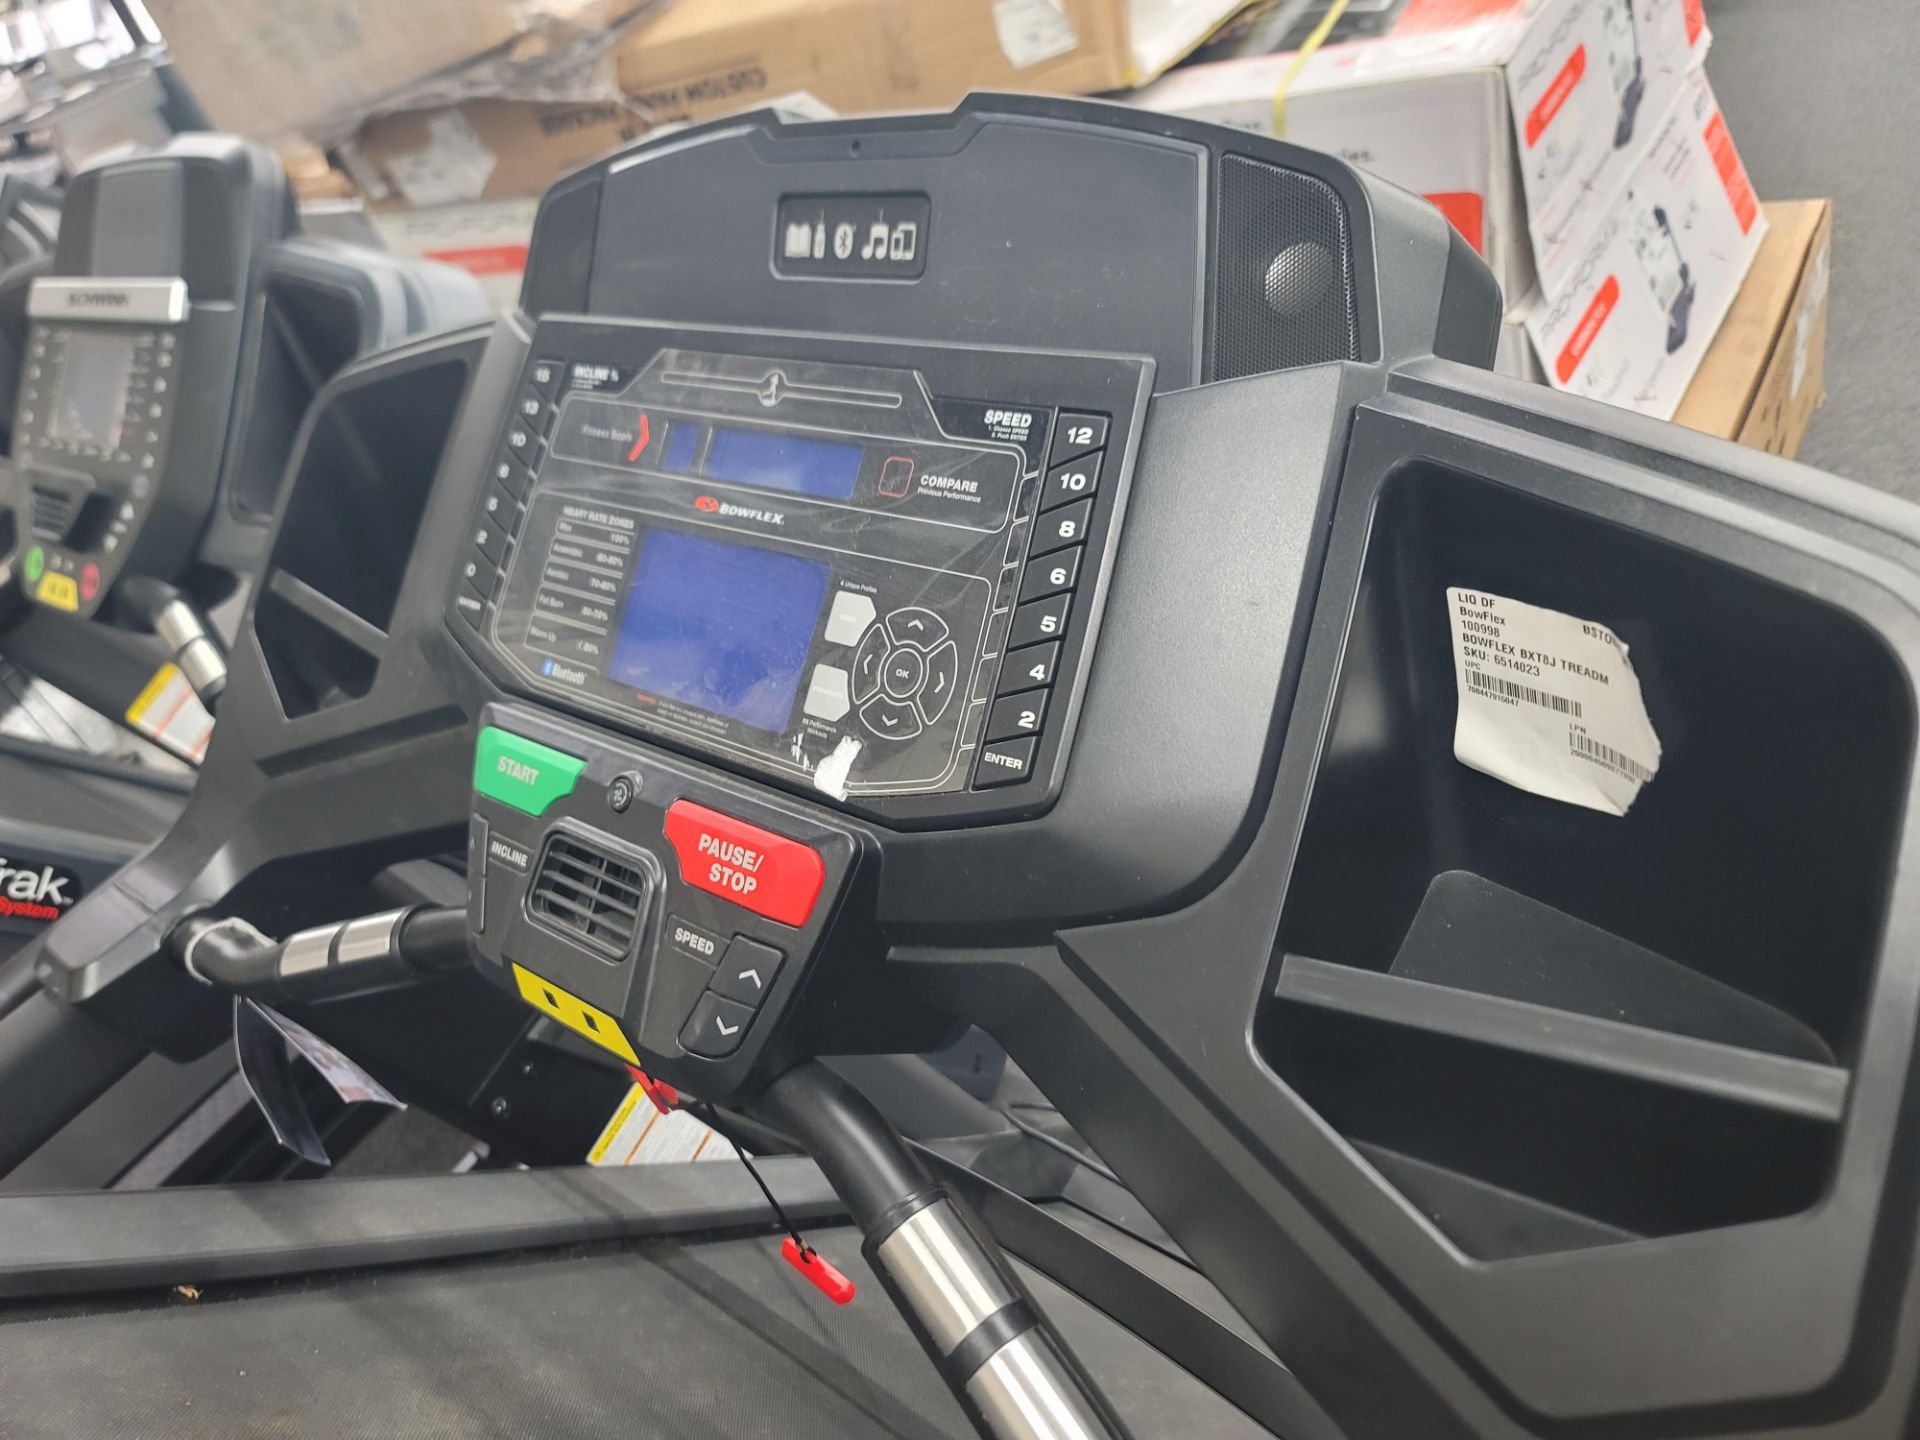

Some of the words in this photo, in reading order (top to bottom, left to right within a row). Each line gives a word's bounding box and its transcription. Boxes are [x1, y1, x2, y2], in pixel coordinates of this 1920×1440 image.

[984, 409, 1032, 428] SPEED
[1067, 427, 1092, 445] 12
[920, 474, 979, 493] COMPARE
[1060, 474, 1086, 491] 10
[943, 490, 981, 503] Performance
[720, 502, 785, 525] BOWFLEX
[1058, 520, 1076, 538] 8
[1050, 568, 1067, 585] 6
[1457, 592, 1478, 605] LIQ
[1481, 597, 1496, 609] DF
[1040, 616, 1057, 633] 5
[1459, 606, 1507, 627] BowFlex
[1460, 620, 1501, 638] 100998
[1462, 632, 1516, 655] BOWFLEX
[1520, 648, 1556, 667] BXT8J
[1560, 659, 1610, 686] TREADM
[1463, 645, 1491, 663] SKU:
[1494, 655, 1541, 677] 6514023
[1464, 659, 1482, 671] UPC
[552, 663, 587, 685] Bluetooth
[895, 668, 909, 679] OK
[1029, 664, 1045, 681] 4
[1018, 711, 1036, 729] 2
[1569, 722, 1587, 734] LPN
[984, 752, 1023, 770] ENTER
[498, 756, 540, 785] START
[491, 840, 529, 868] INCLINE
[698, 833, 765, 873] PAUSE/
[708, 863, 757, 896] STOP
[674, 927, 715, 956] SPEED
